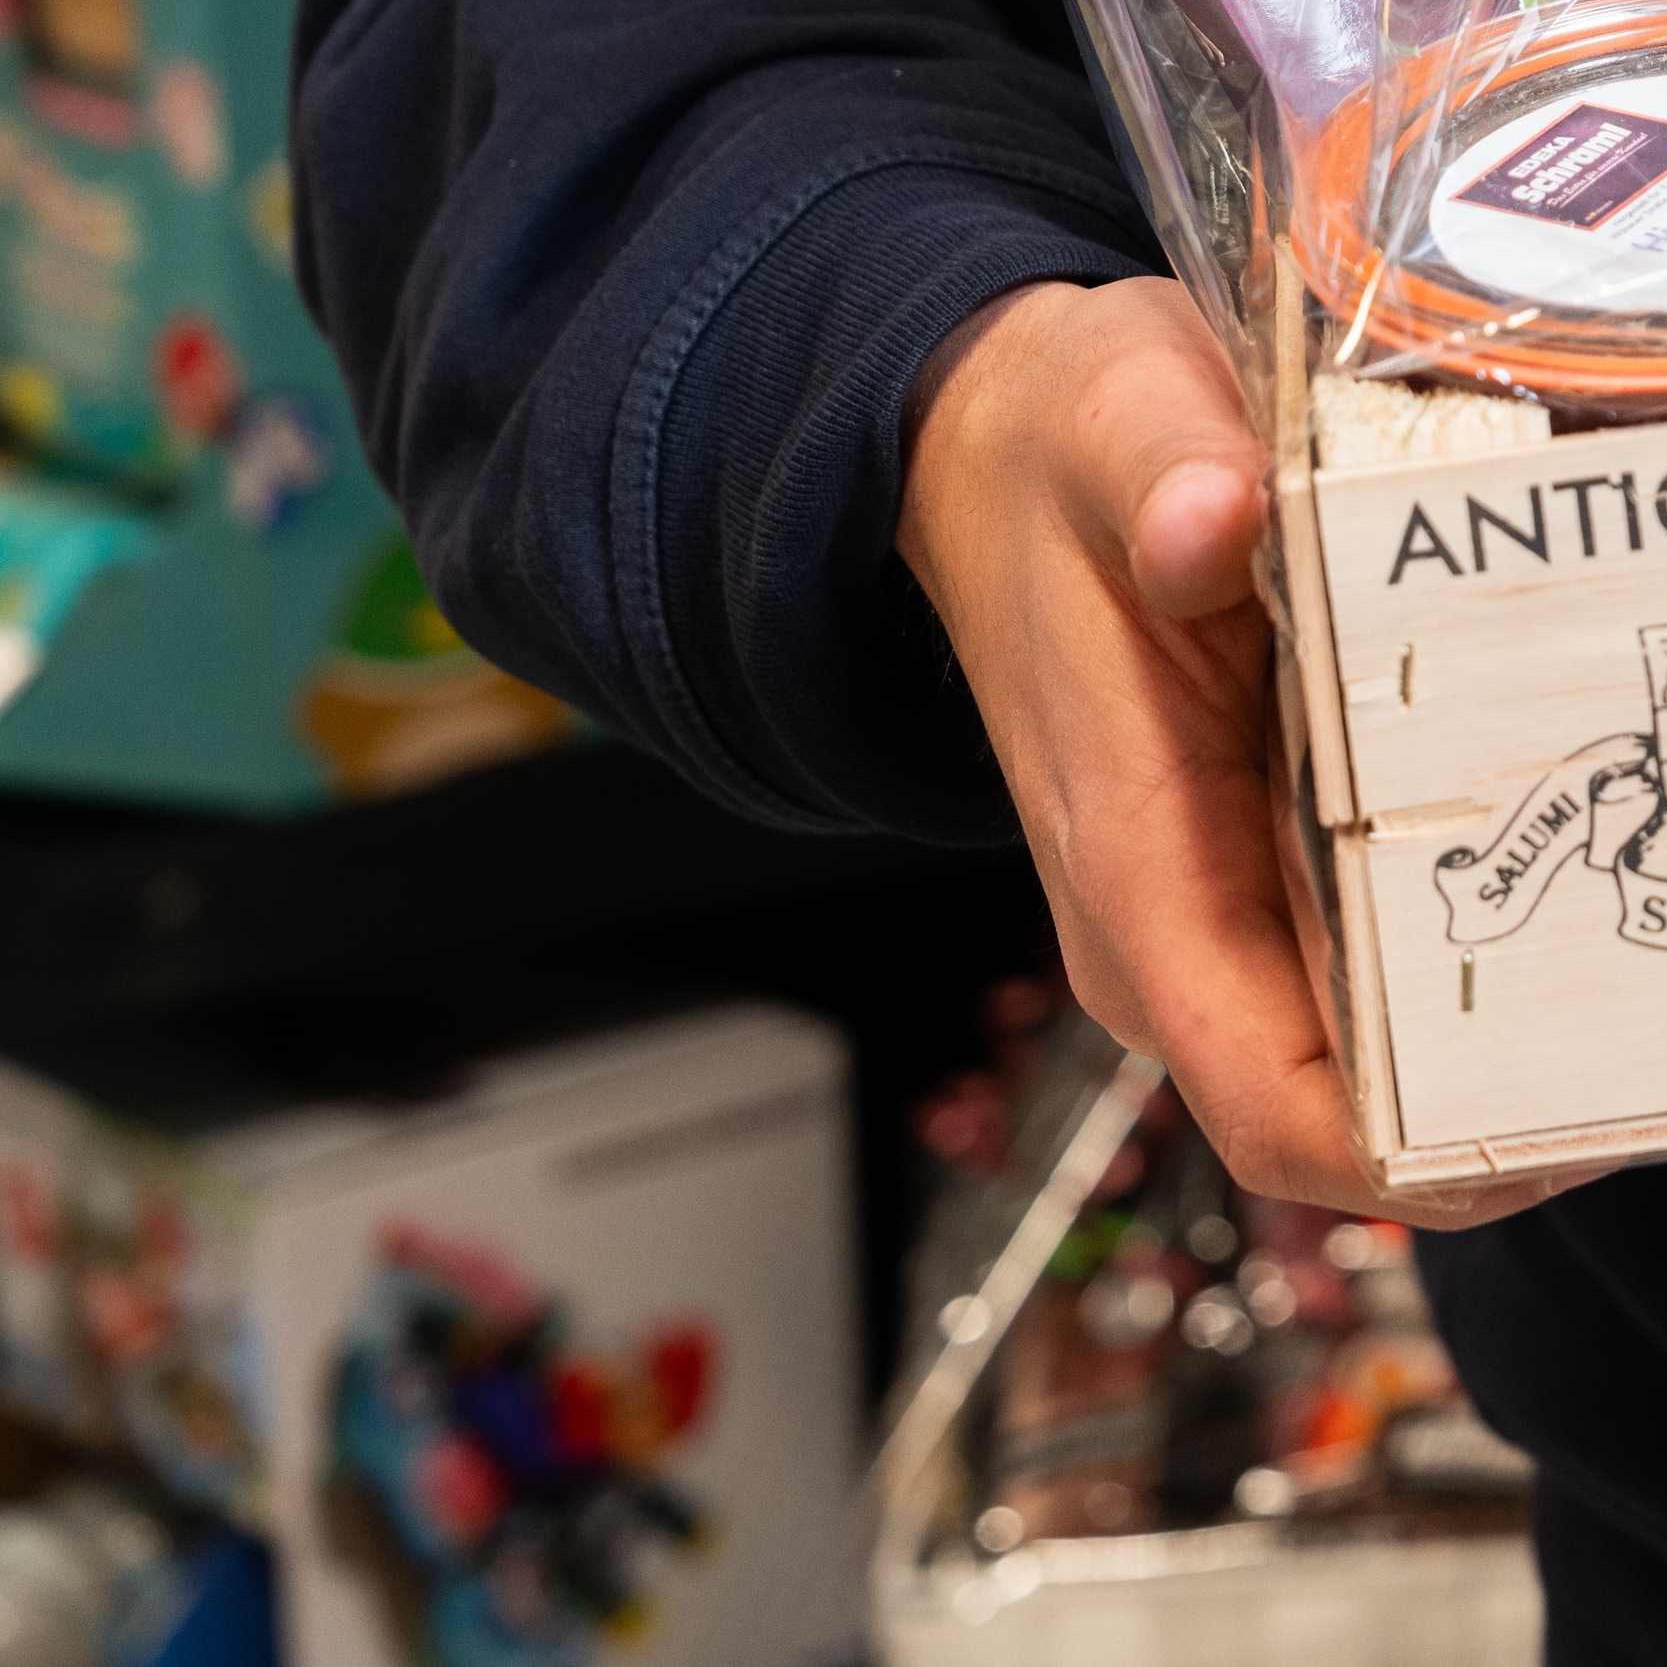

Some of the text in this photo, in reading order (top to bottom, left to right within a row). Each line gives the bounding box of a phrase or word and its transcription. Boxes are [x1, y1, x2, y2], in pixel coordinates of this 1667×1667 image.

[1507, 136, 1577, 179] EDEKA
[1510, 122, 1632, 205] Schraml
[1477, 791, 1584, 912] SALUMI
